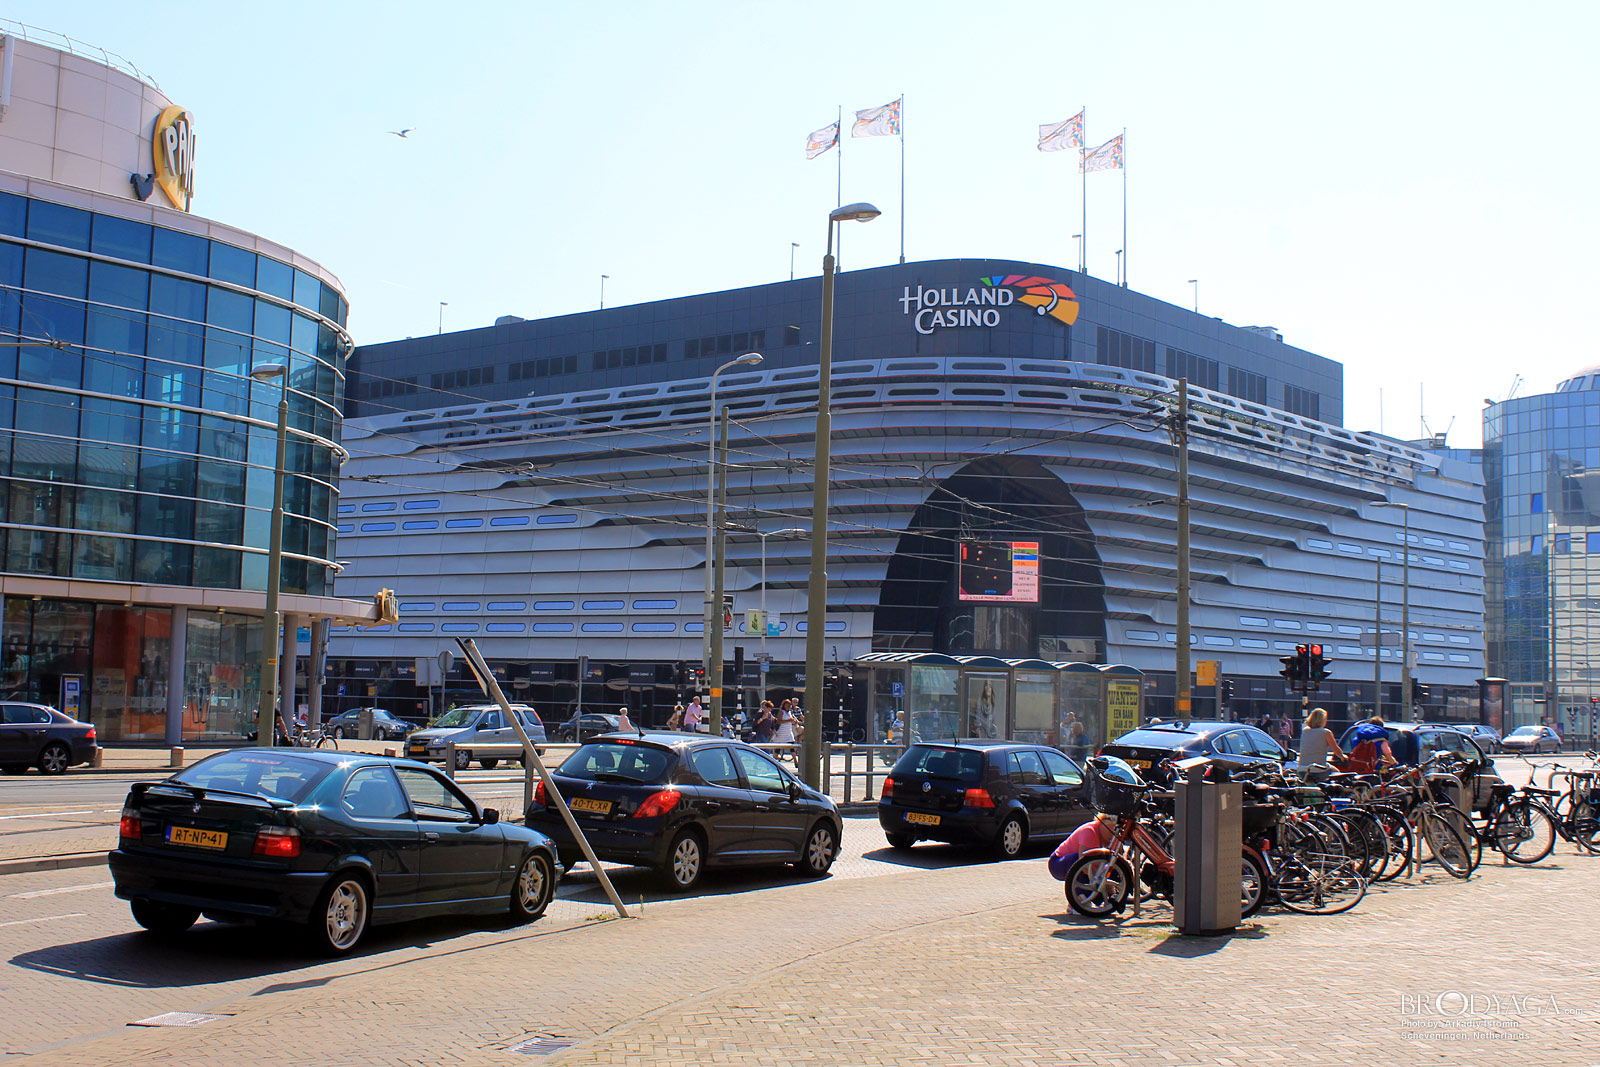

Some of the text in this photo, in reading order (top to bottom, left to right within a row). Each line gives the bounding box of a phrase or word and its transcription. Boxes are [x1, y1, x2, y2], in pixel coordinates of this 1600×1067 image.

[899, 285, 1014, 314] HOLLAND
[915, 308, 1000, 334] CASINO
[1108, 690, 1138, 706] WANTED
[573, 799, 608, 810] 40-TL-XR
[175, 829, 222, 845] RT-NP-41
